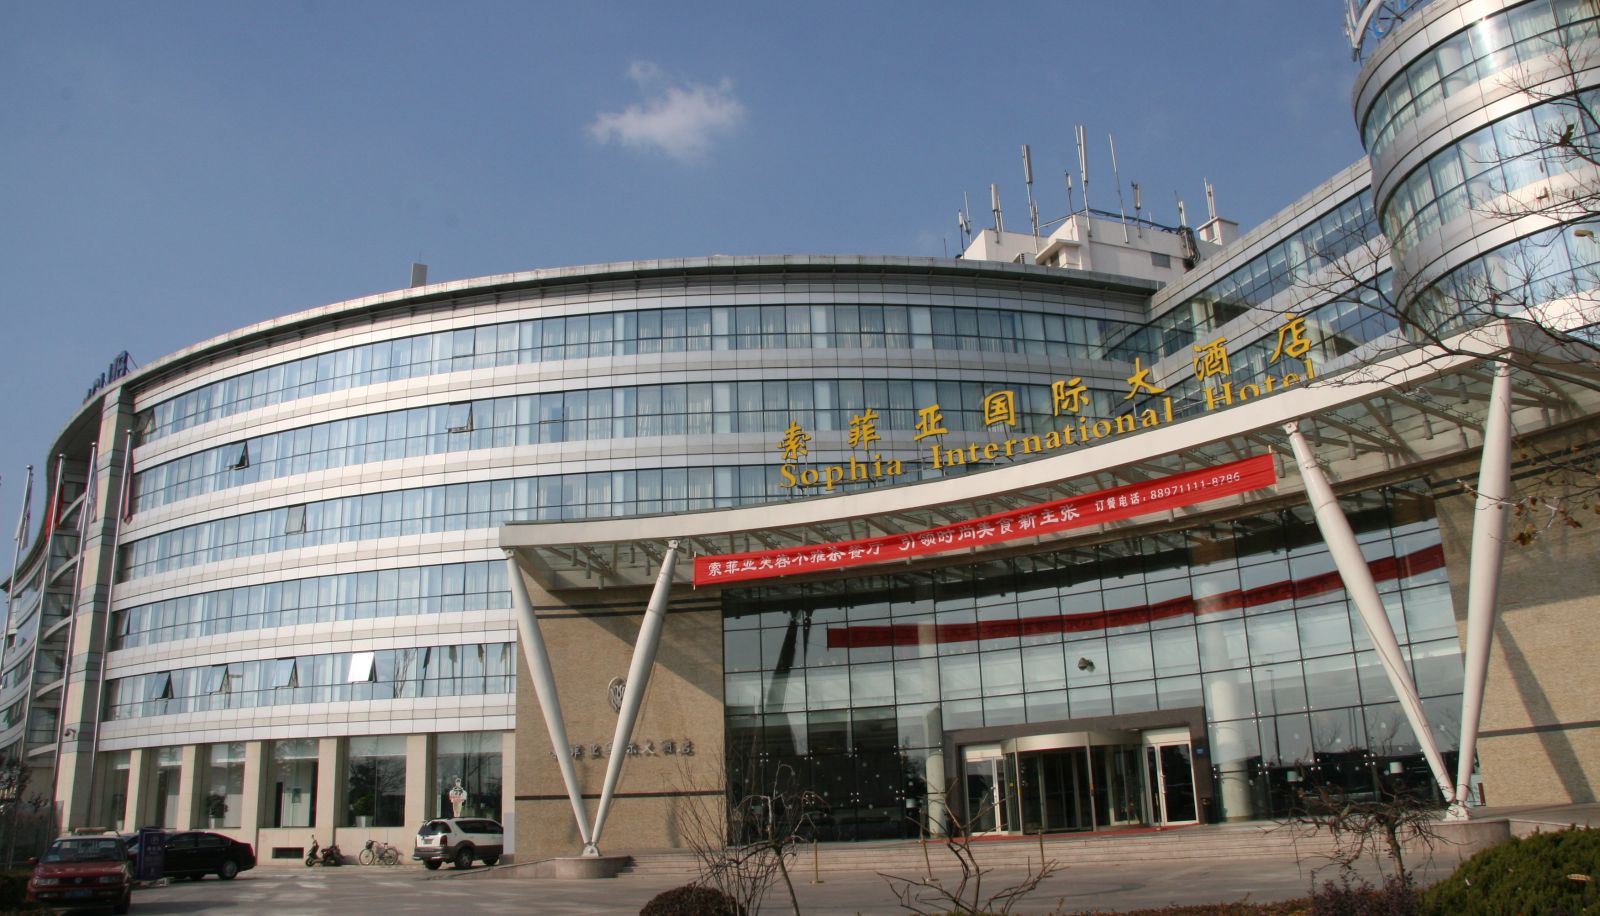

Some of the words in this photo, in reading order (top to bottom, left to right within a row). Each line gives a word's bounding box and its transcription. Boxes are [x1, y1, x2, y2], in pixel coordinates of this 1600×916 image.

[777, 312, 1312, 461] 索菲亚国际大酒店
[779, 453, 903, 491] Sophia
[930, 396, 1174, 470] International
[1204, 358, 1316, 411] Hotel
[898, 503, 1081, 551] 引领时尚美食新主张
